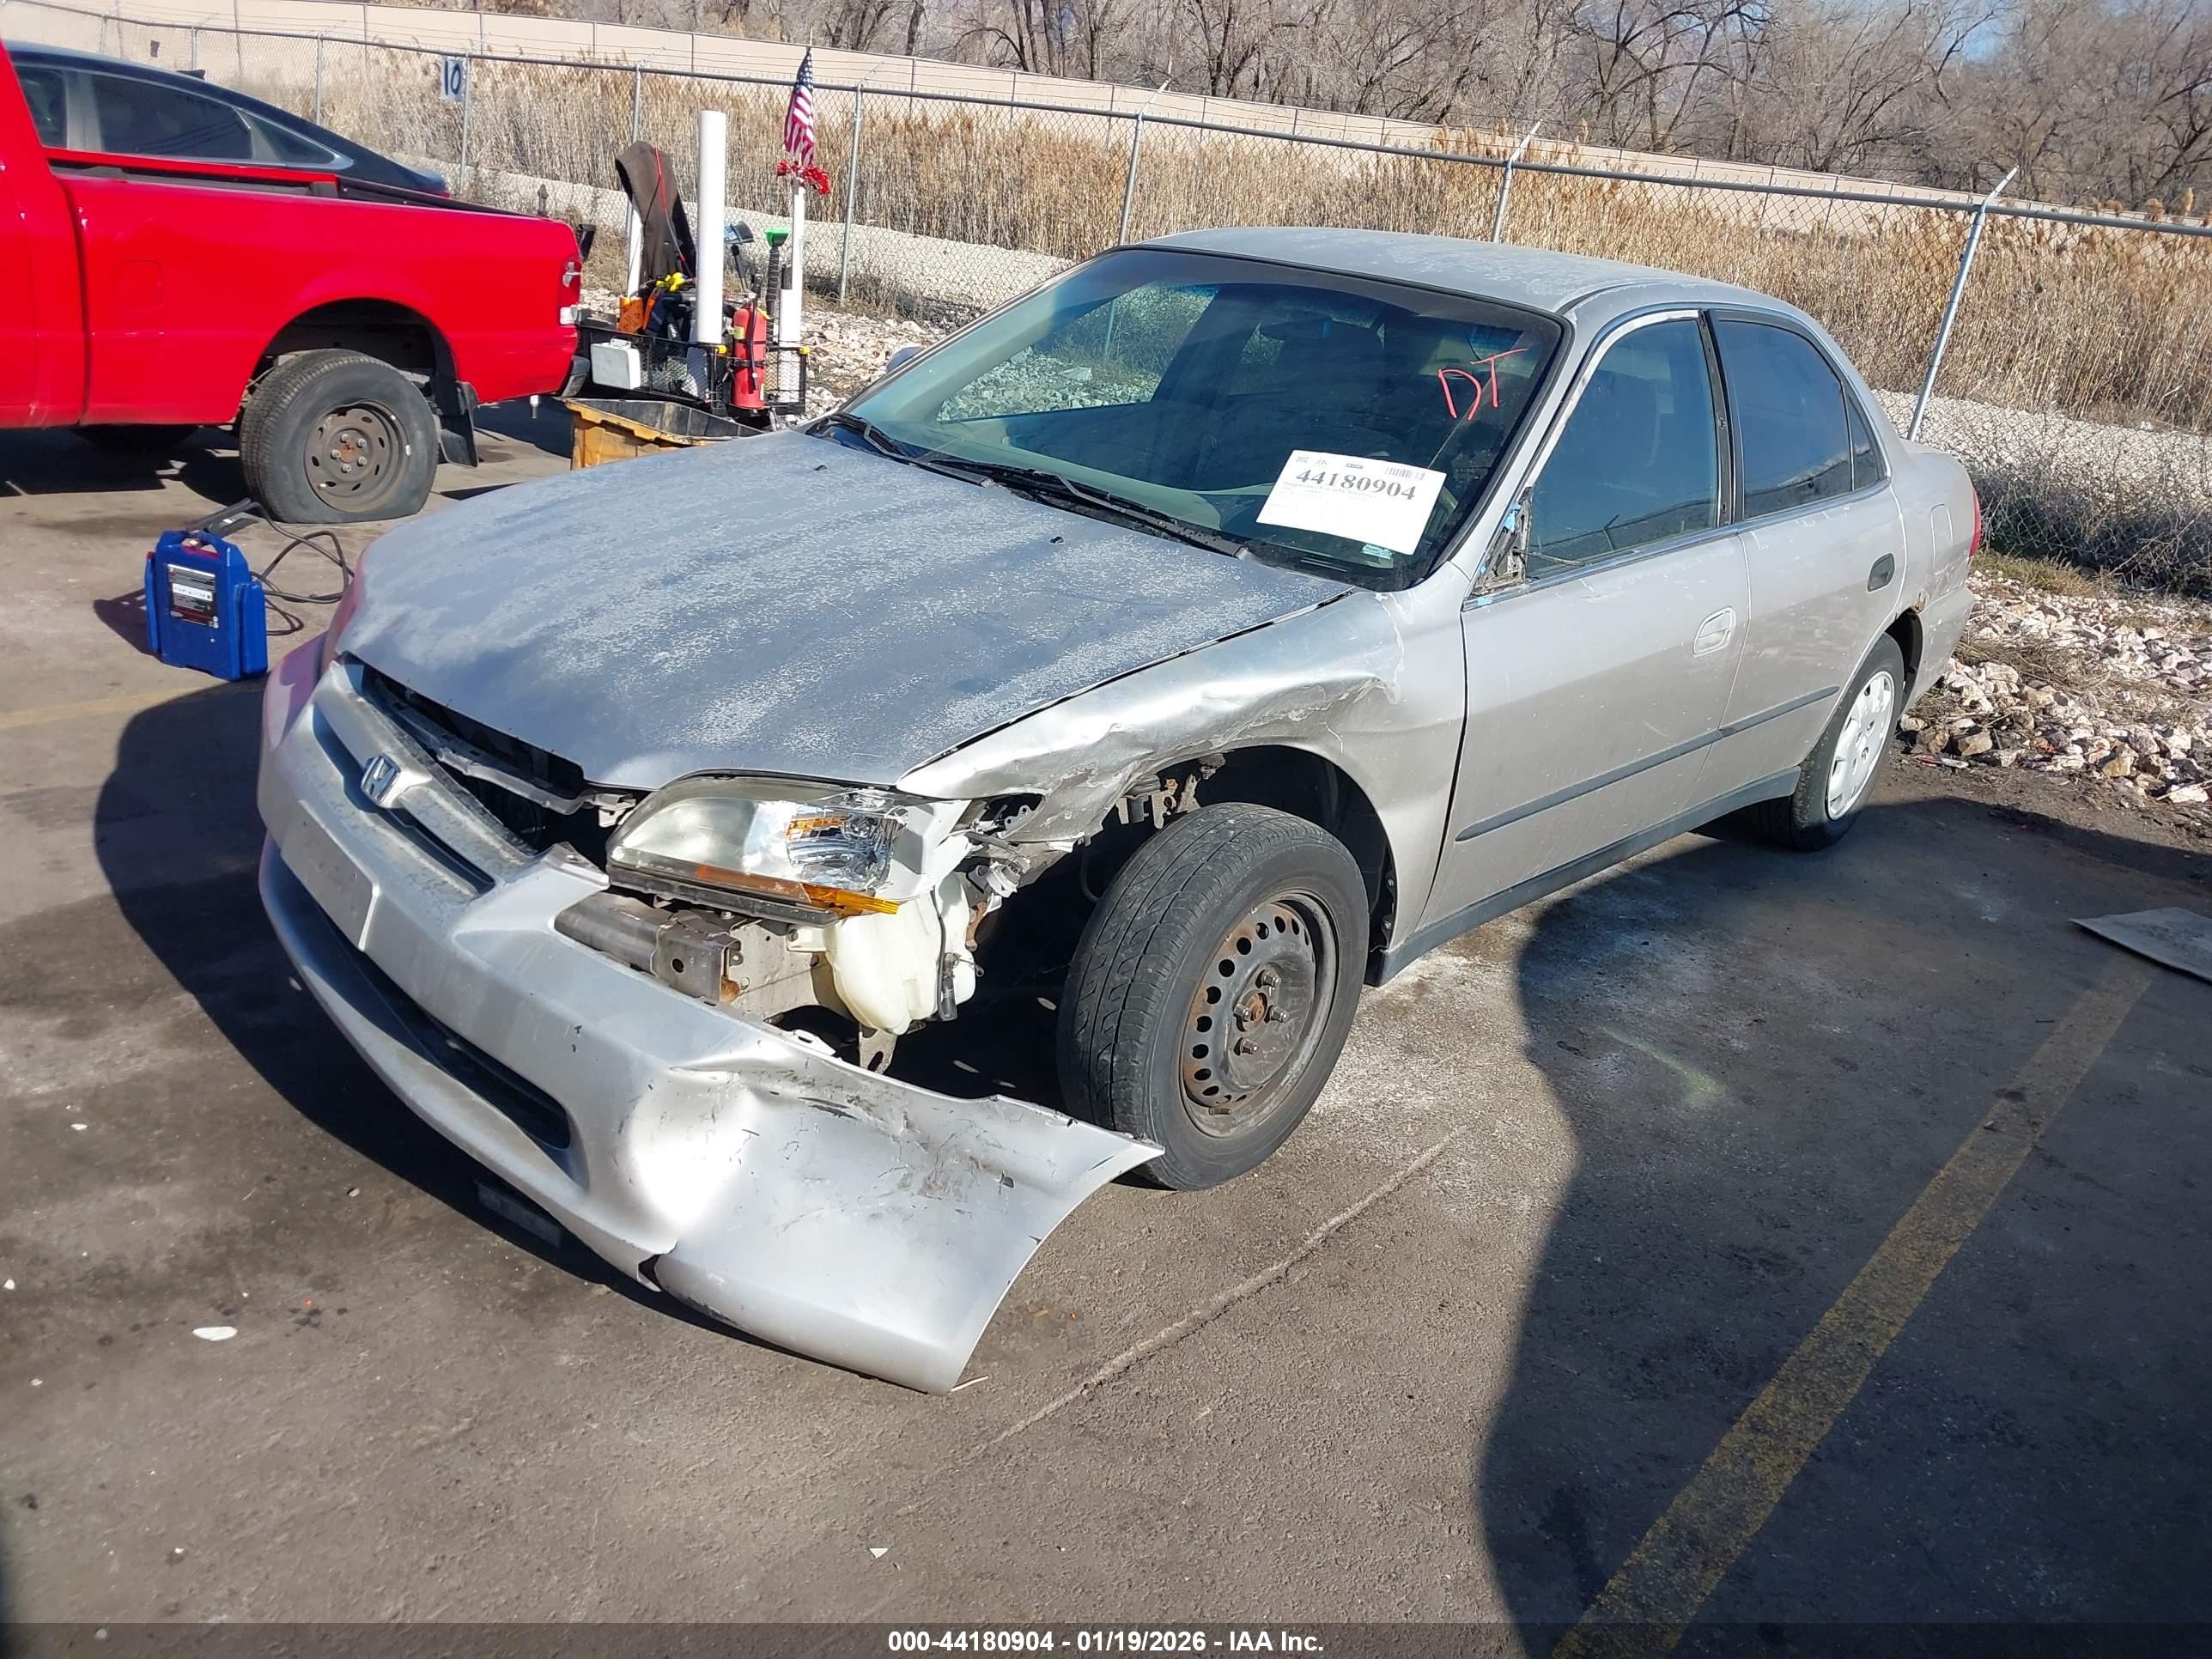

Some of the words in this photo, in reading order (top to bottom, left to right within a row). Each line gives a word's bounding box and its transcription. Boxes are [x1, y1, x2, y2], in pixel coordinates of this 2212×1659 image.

[444, 59, 462, 95] 10
[1437, 348, 1528, 422] DT
[1296, 469, 1416, 501] 44180904
